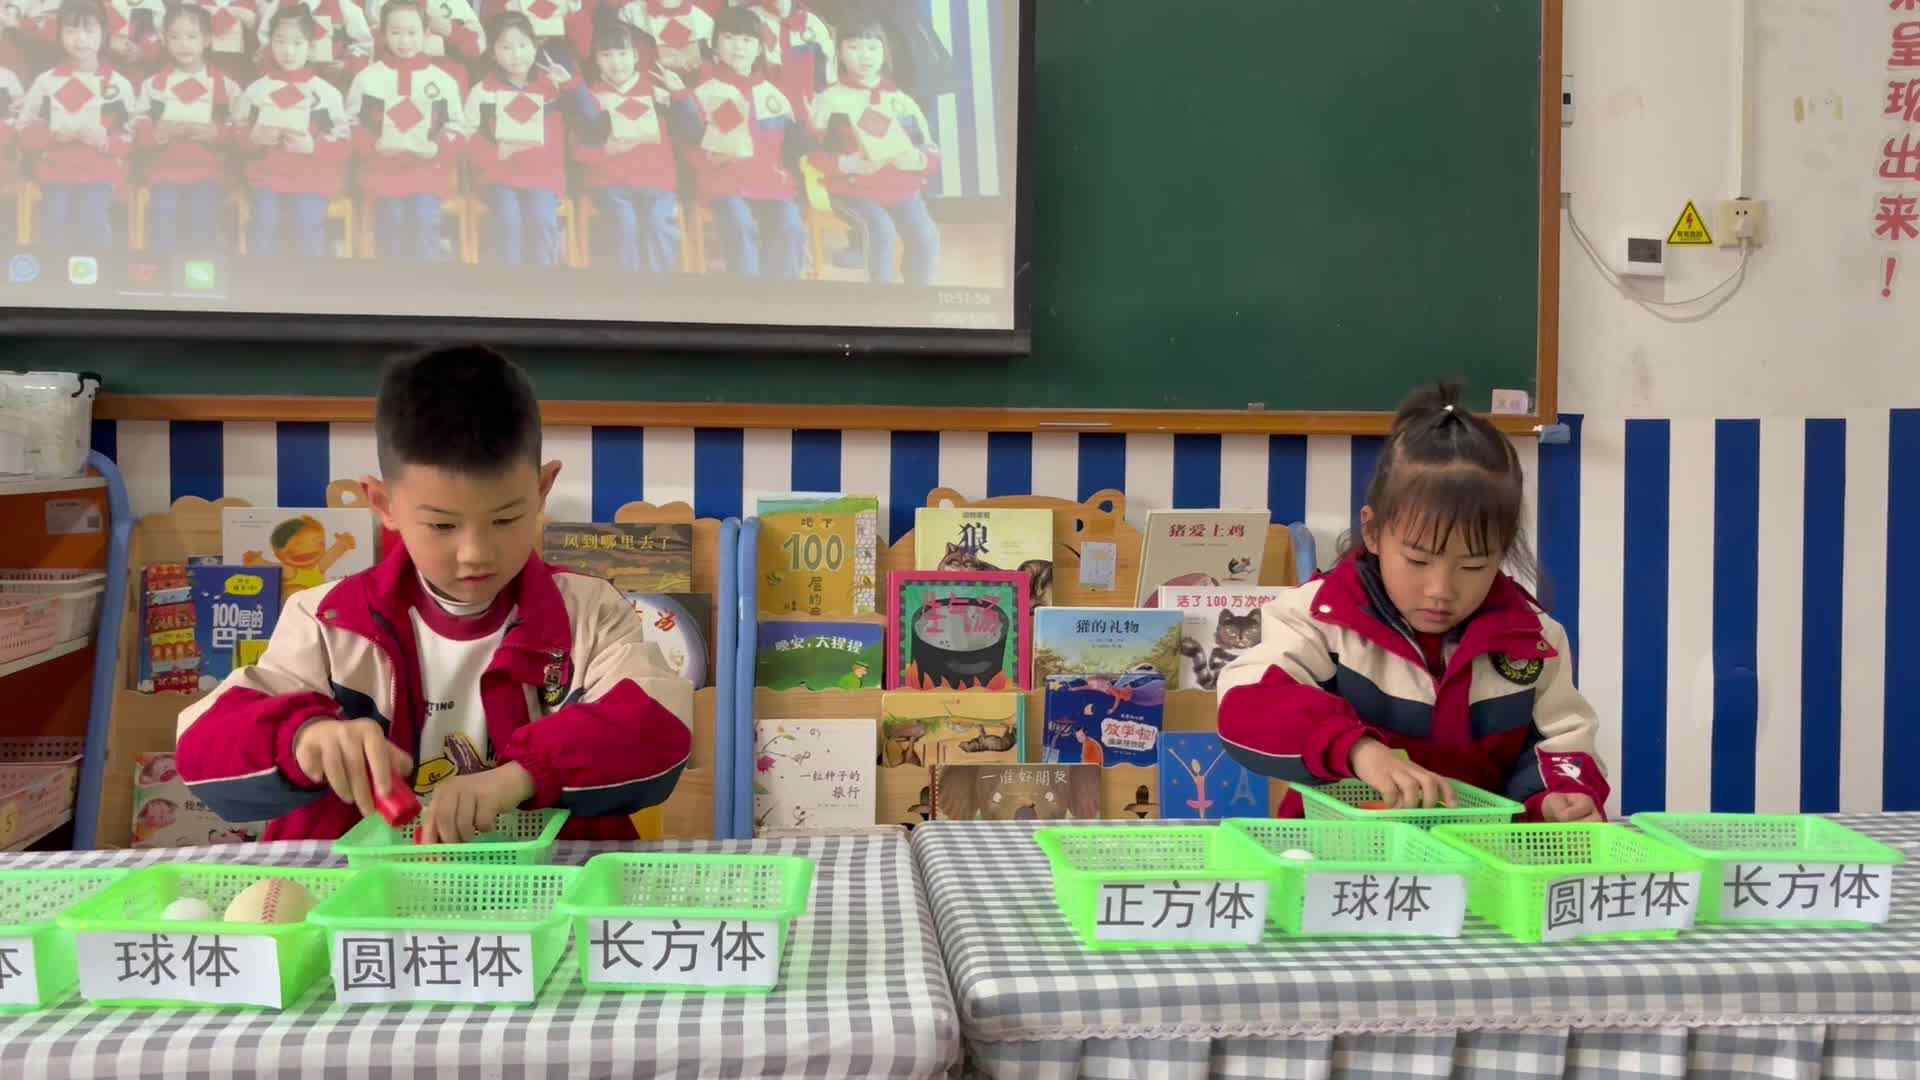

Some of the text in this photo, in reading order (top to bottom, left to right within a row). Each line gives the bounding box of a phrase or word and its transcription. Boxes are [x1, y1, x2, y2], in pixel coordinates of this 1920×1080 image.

[1875, 0, 1920, 298] 呈现出来！
[563, 534, 672, 551] 风到哪里去了
[783, 533, 844, 572] 100
[958, 522, 989, 556] 狼
[1177, 595, 1276, 608] 活了100万次的
[832, 785, 861, 799] 旅行
[1097, 880, 1255, 929] 正方体
[1331, 874, 1432, 923] 球体
[1547, 872, 1690, 930] 圆柱体
[1723, 863, 1881, 910] 长方体
[114, 933, 240, 988] 球体
[342, 935, 523, 991] 圆柱体
[590, 919, 767, 973] 长方体
